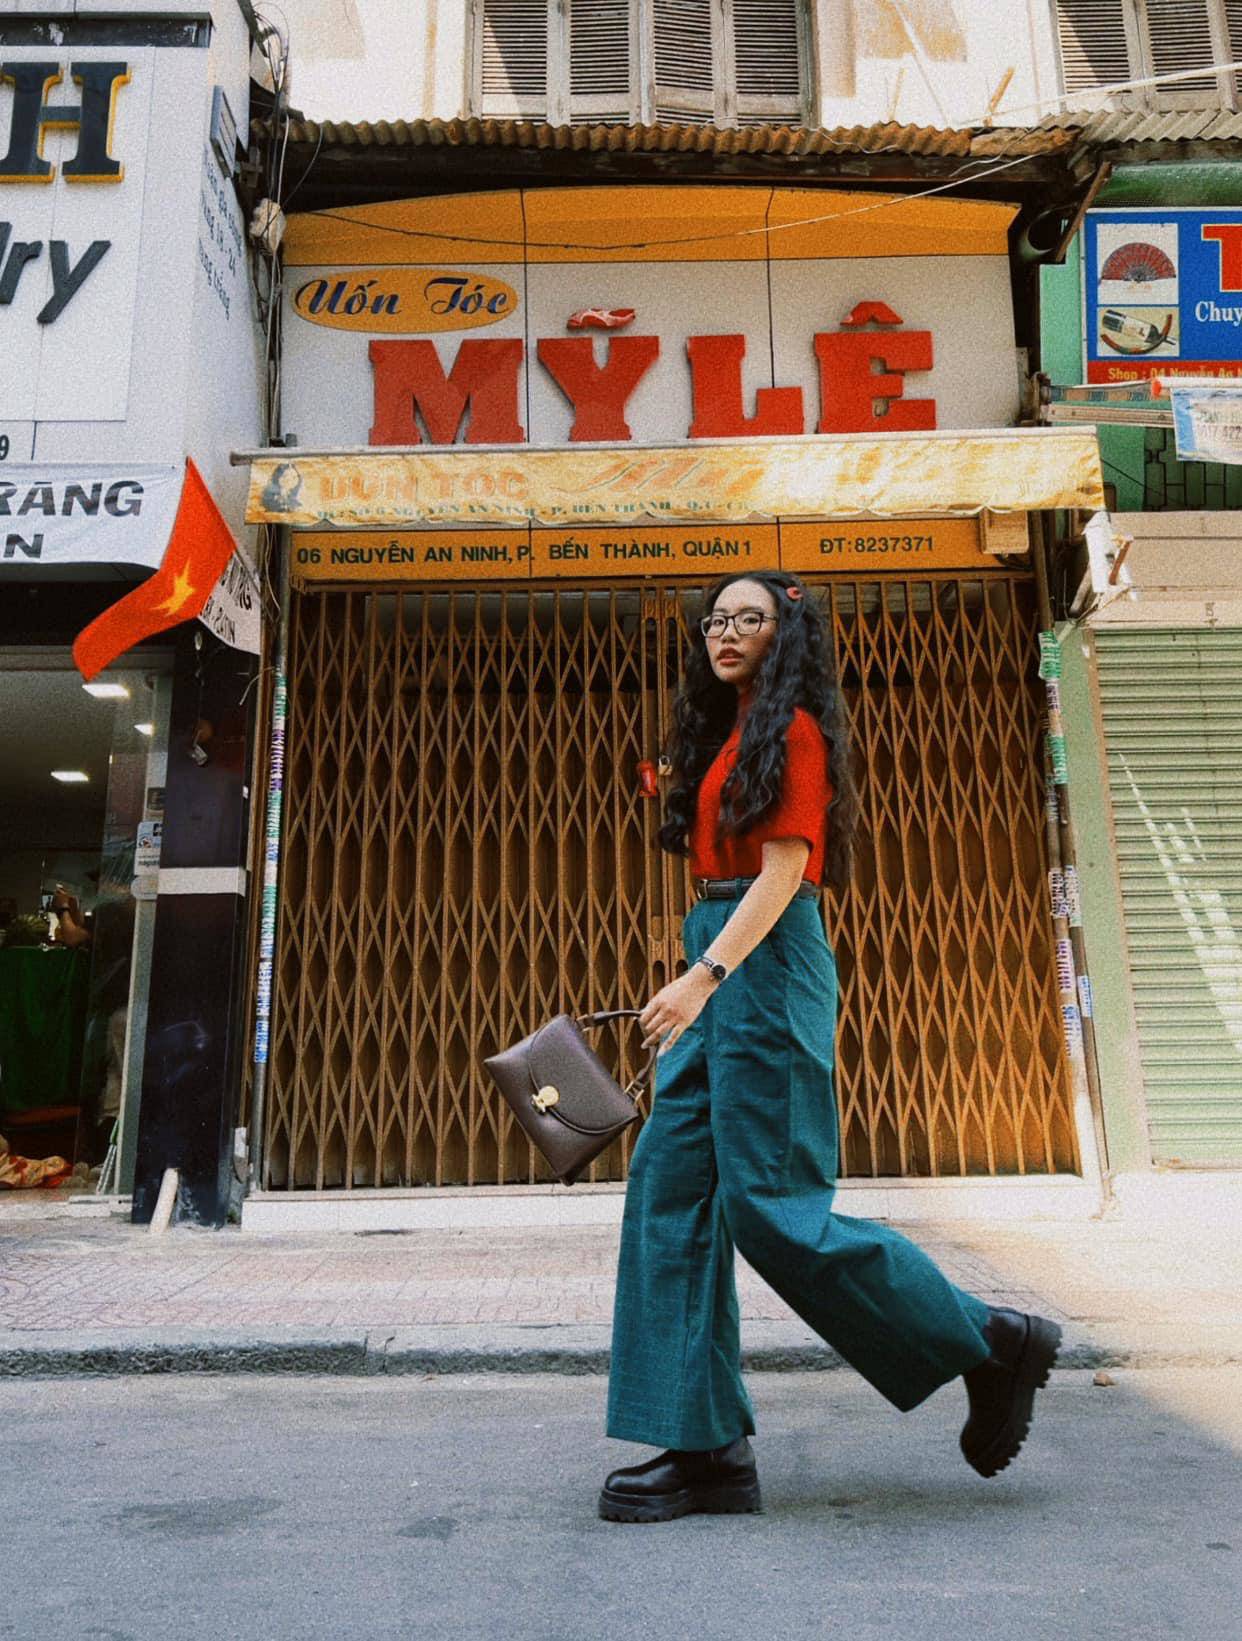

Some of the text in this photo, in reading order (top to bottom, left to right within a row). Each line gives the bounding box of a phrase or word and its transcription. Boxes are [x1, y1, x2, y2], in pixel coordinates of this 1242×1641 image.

[0, 61, 131, 183] H
[295, 277, 508, 315] Uốn Tóc
[1107, 367, 1138, 380] Shop
[297, 547, 321, 564] 06
[330, 540, 415, 565] NGUYỄN
[424, 546, 452, 562] AN
[549, 536, 589, 560] BẾN
[600, 538, 676, 559] THÀNH,
[819, 536, 933, 554] ĐT:8237371
